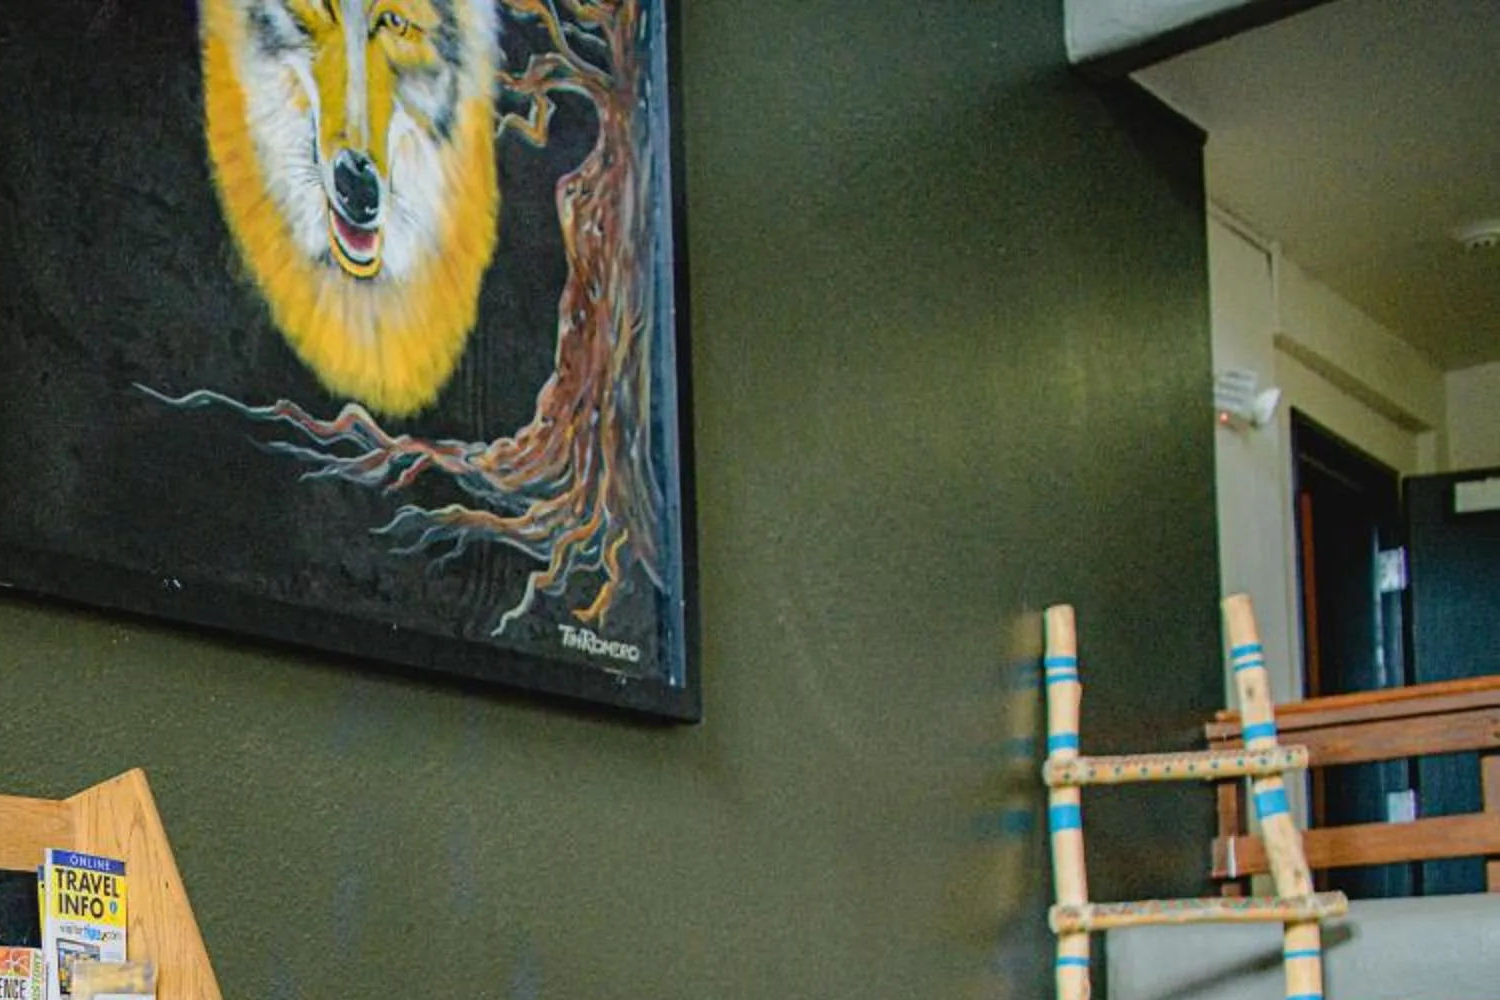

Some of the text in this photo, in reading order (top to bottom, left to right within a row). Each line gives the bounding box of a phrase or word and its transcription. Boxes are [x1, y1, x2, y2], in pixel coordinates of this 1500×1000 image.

[69, 854, 112, 871] ONLINE
[54, 868, 120, 898] TRAVEL
[58, 897, 105, 919] INFO
